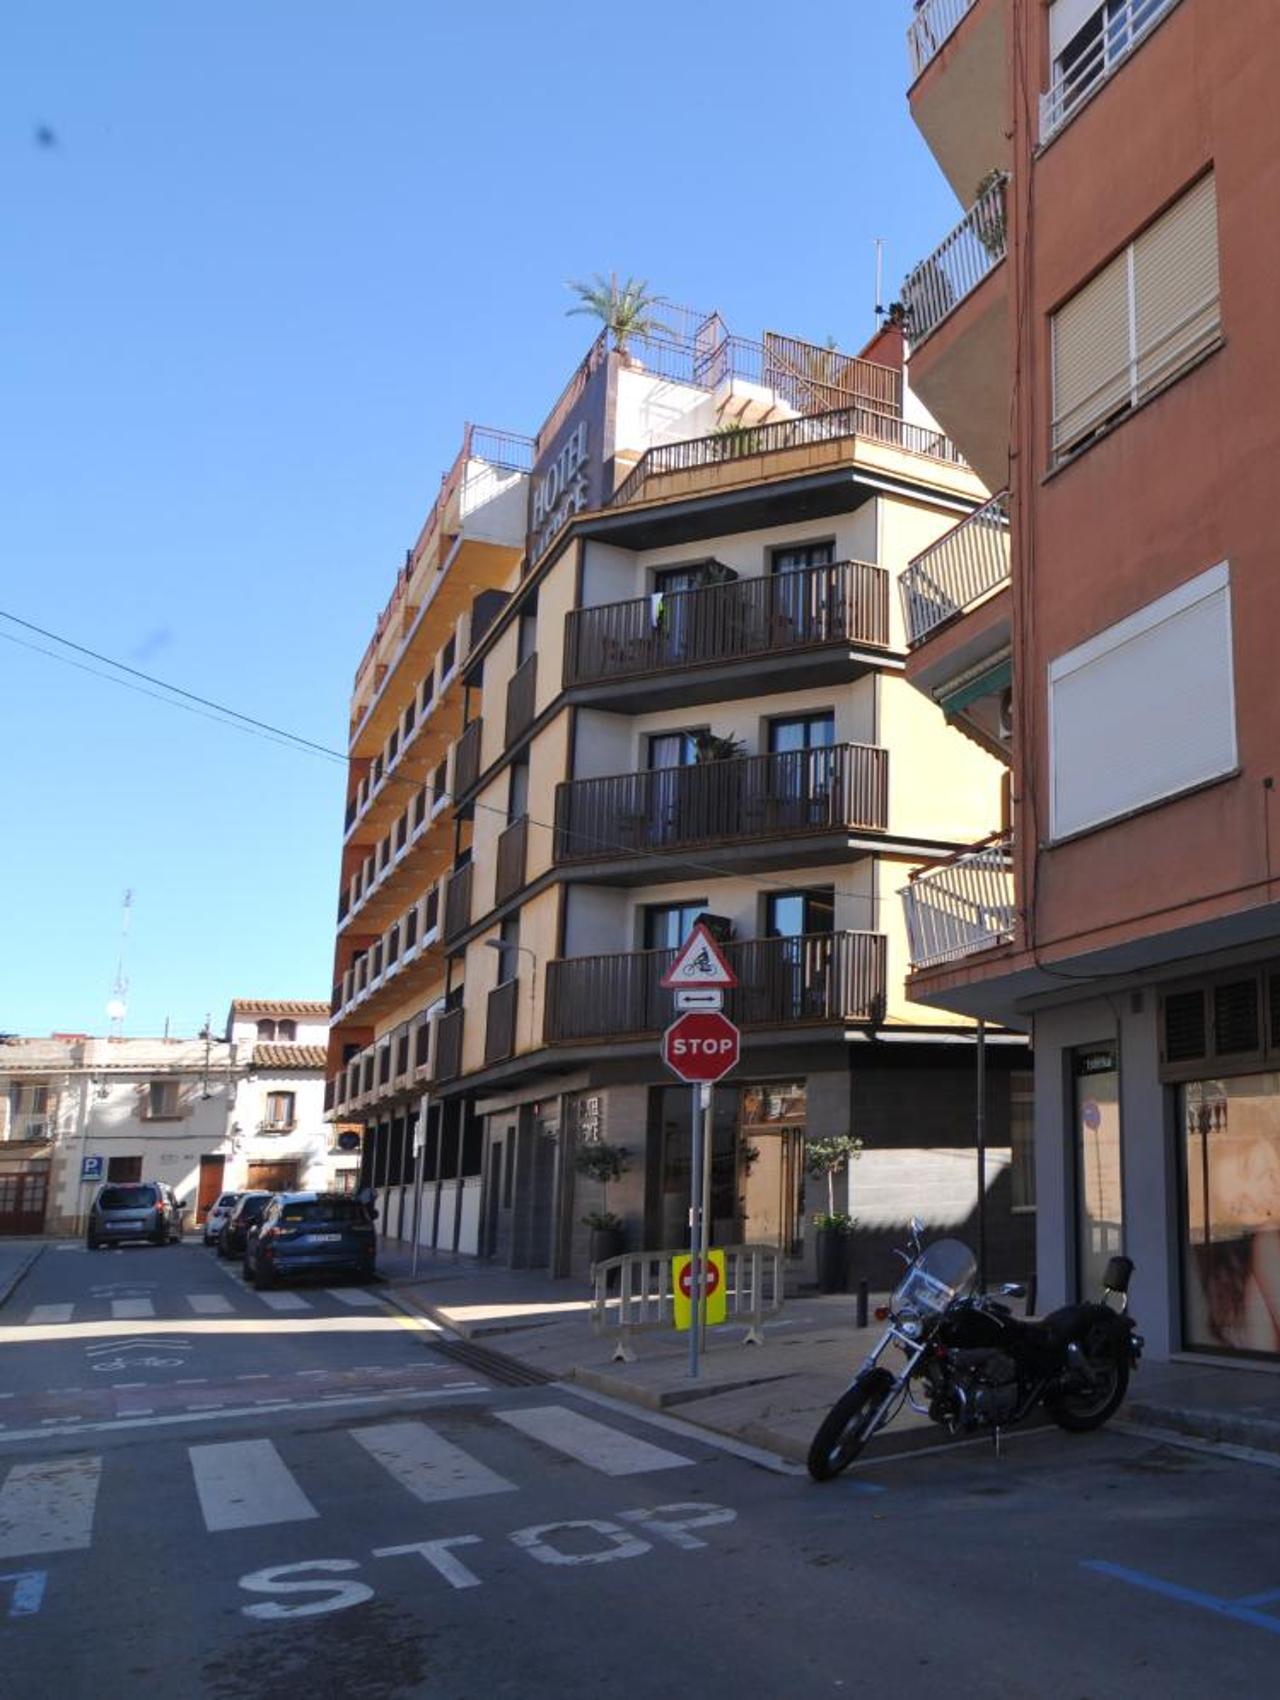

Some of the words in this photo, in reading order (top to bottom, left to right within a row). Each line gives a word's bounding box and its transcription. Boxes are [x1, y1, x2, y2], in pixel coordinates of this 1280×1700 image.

[532, 420, 589, 531] HOTEL
[673, 1038, 733, 1055] STOP
[85, 1158, 98, 1172] P
[238, 1502, 738, 1619] STOP
